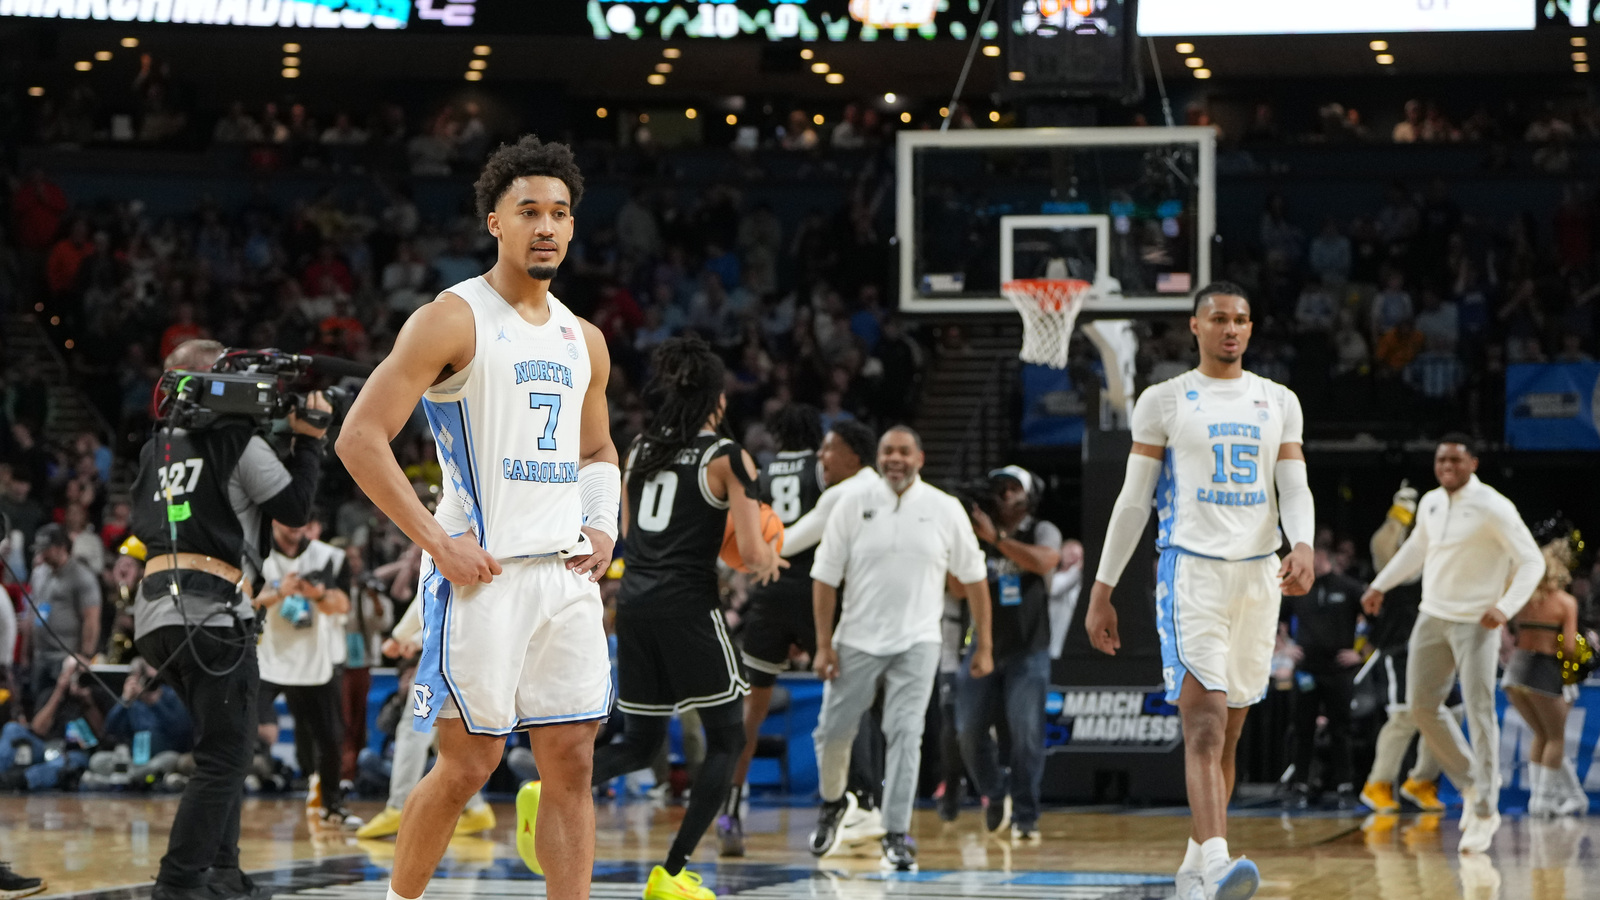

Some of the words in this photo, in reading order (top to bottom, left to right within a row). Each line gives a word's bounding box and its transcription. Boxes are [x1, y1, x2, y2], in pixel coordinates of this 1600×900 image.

[514, 360, 573, 389] NORTH
[529, 392, 562, 451] 7
[1208, 422, 1261, 440] NORTH
[1212, 443, 1259, 484] 15
[637, 470, 679, 532] 0
[770, 475, 802, 524] 8
[1197, 487, 1266, 507] CAROLINA
[1062, 691, 1144, 716] MARCH
[1071, 715, 1180, 741] MADNESS
